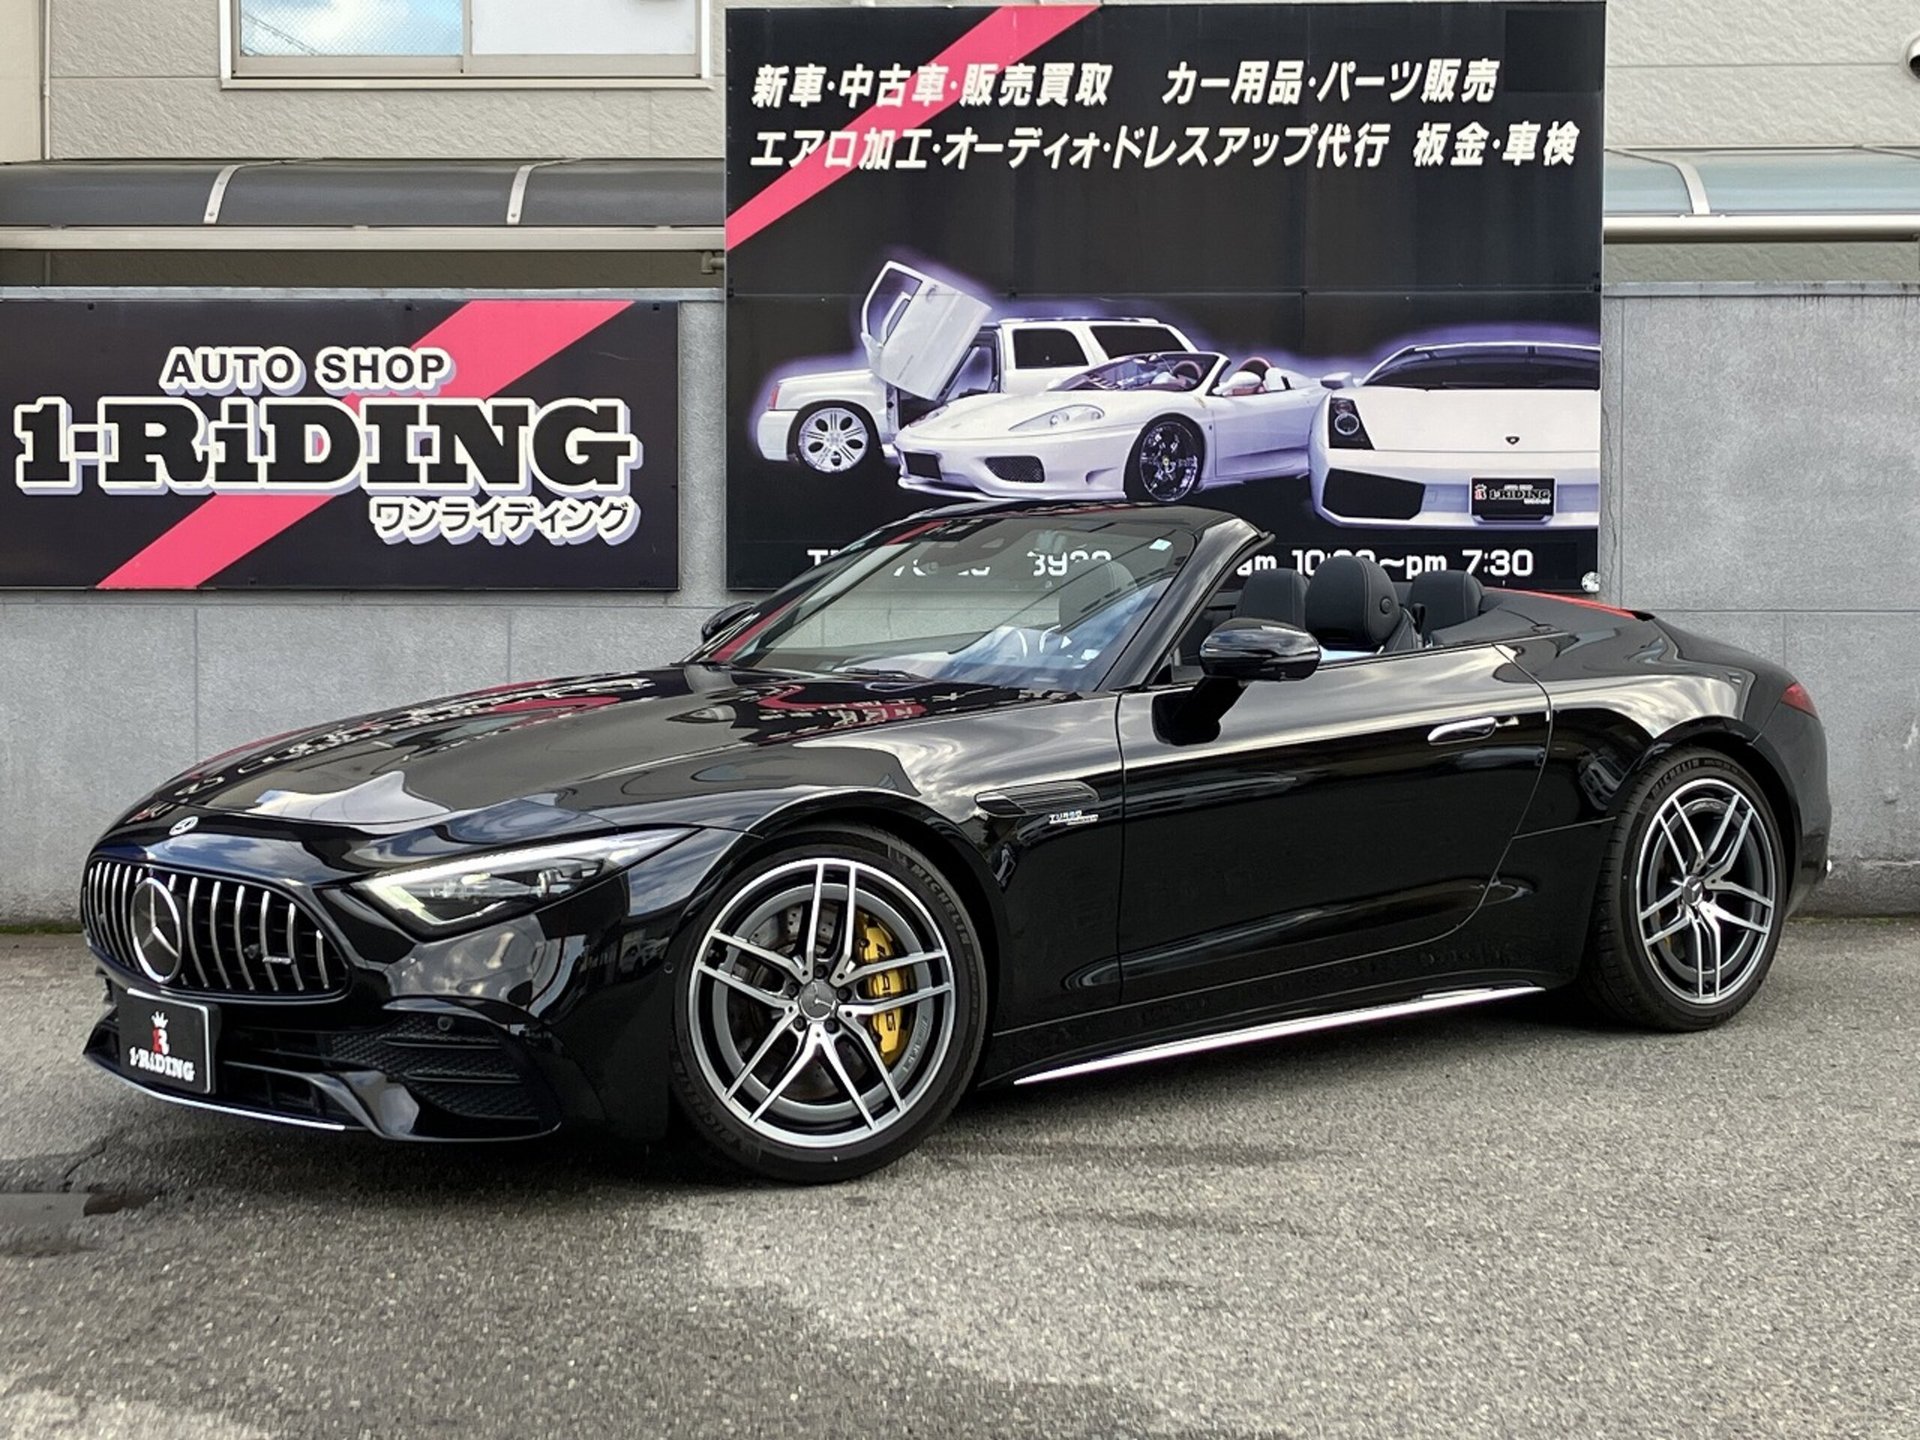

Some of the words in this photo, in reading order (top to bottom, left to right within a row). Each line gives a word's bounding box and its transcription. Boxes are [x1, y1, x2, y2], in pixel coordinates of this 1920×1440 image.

[751, 63, 1113, 108] 新車・中古車・販売買取
[1162, 58, 1500, 104] カー用品・パーツ販売
[1412, 120, 1581, 167] 板金・車検
[163, 349, 299, 388] AUTO
[317, 348, 449, 387] SHOP
[371, 500, 634, 538] ワンライディング
[1462, 549, 1534, 577] 7:30
